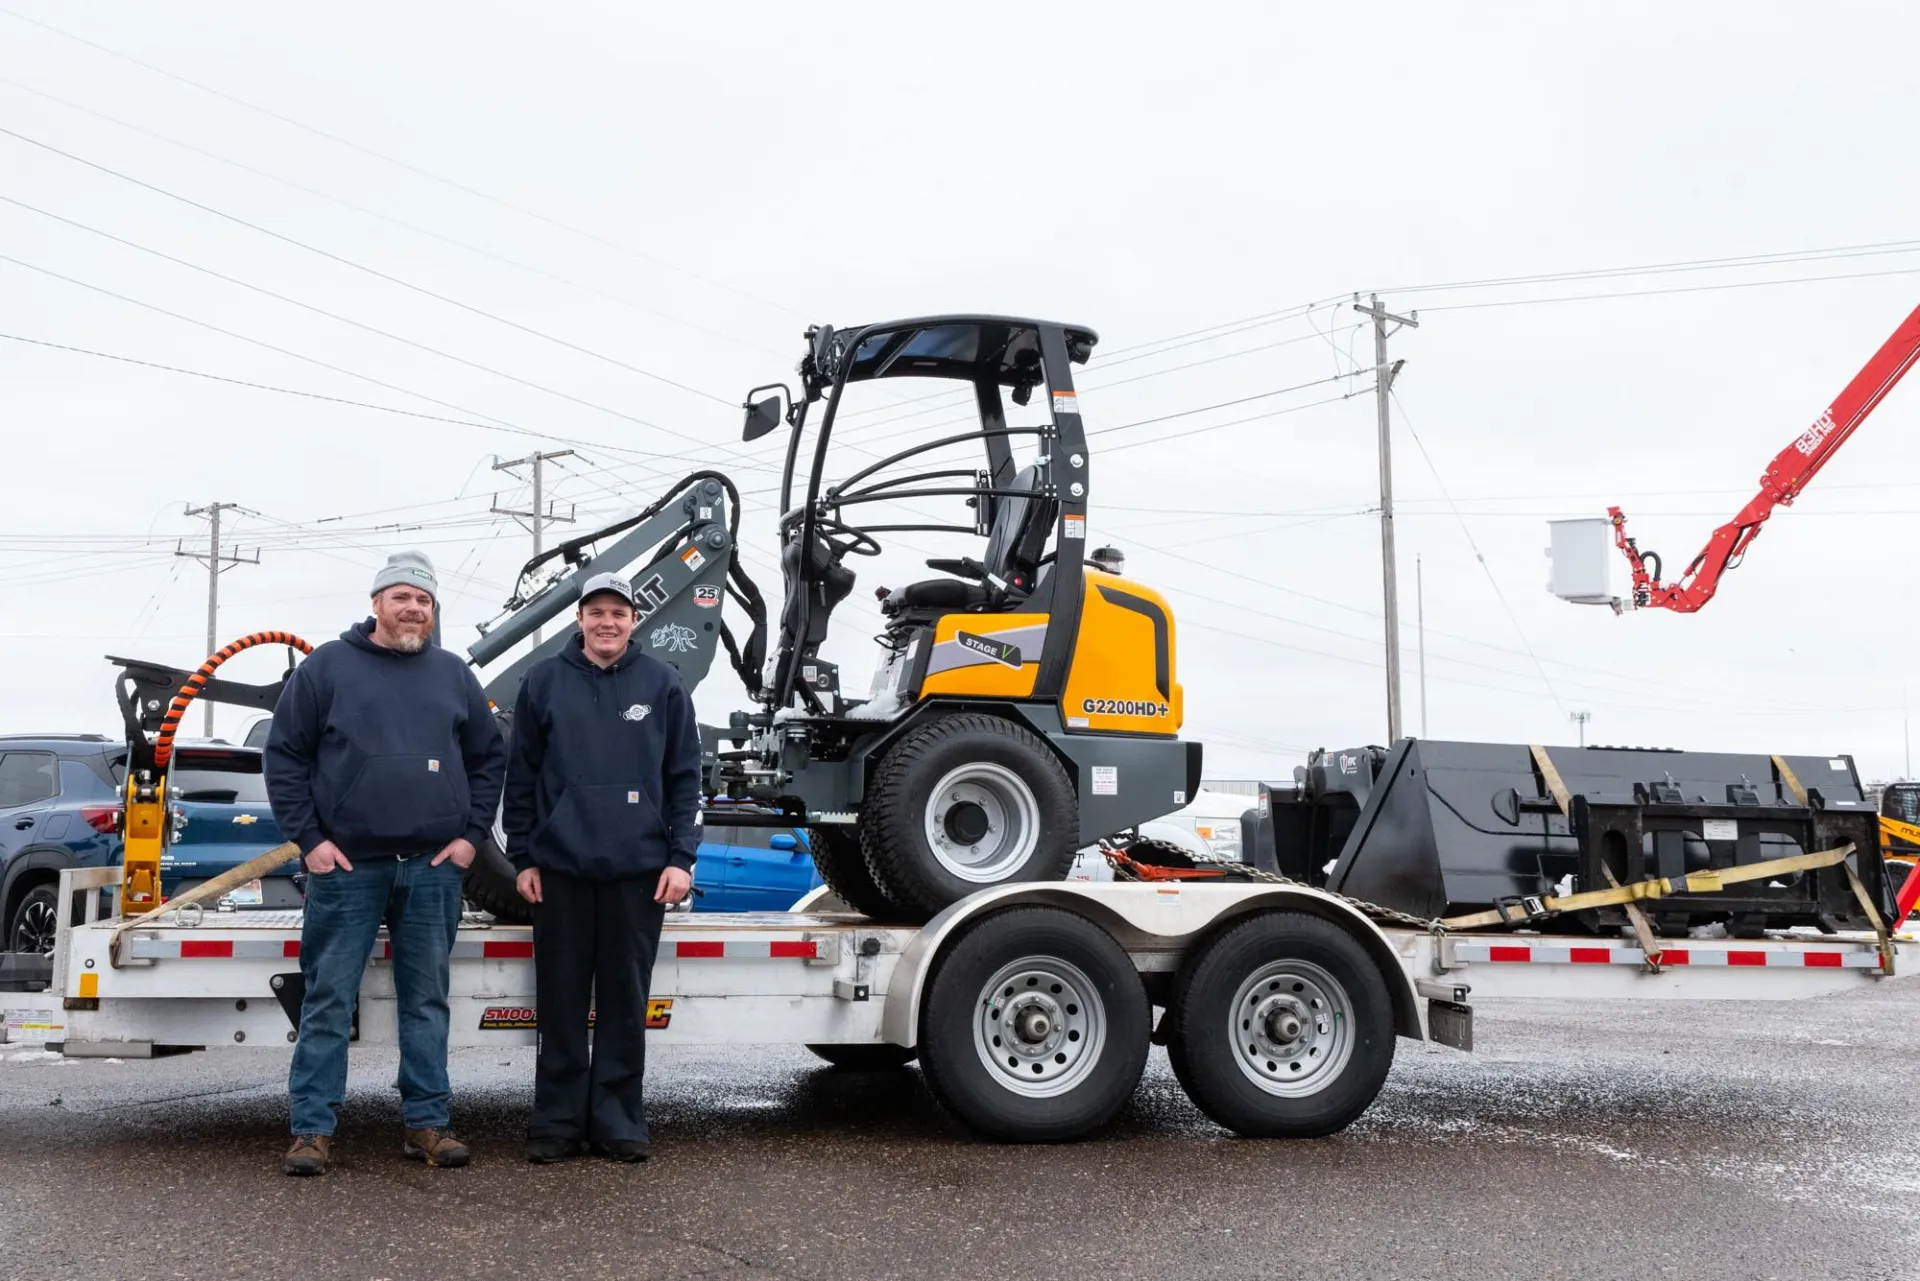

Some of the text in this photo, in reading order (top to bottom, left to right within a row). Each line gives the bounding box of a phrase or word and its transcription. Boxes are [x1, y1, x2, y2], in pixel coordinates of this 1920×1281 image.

[698, 588, 715, 598] 25
[966, 638, 1016, 659] STAGE V
[1083, 698, 1169, 717] G2200HD+
